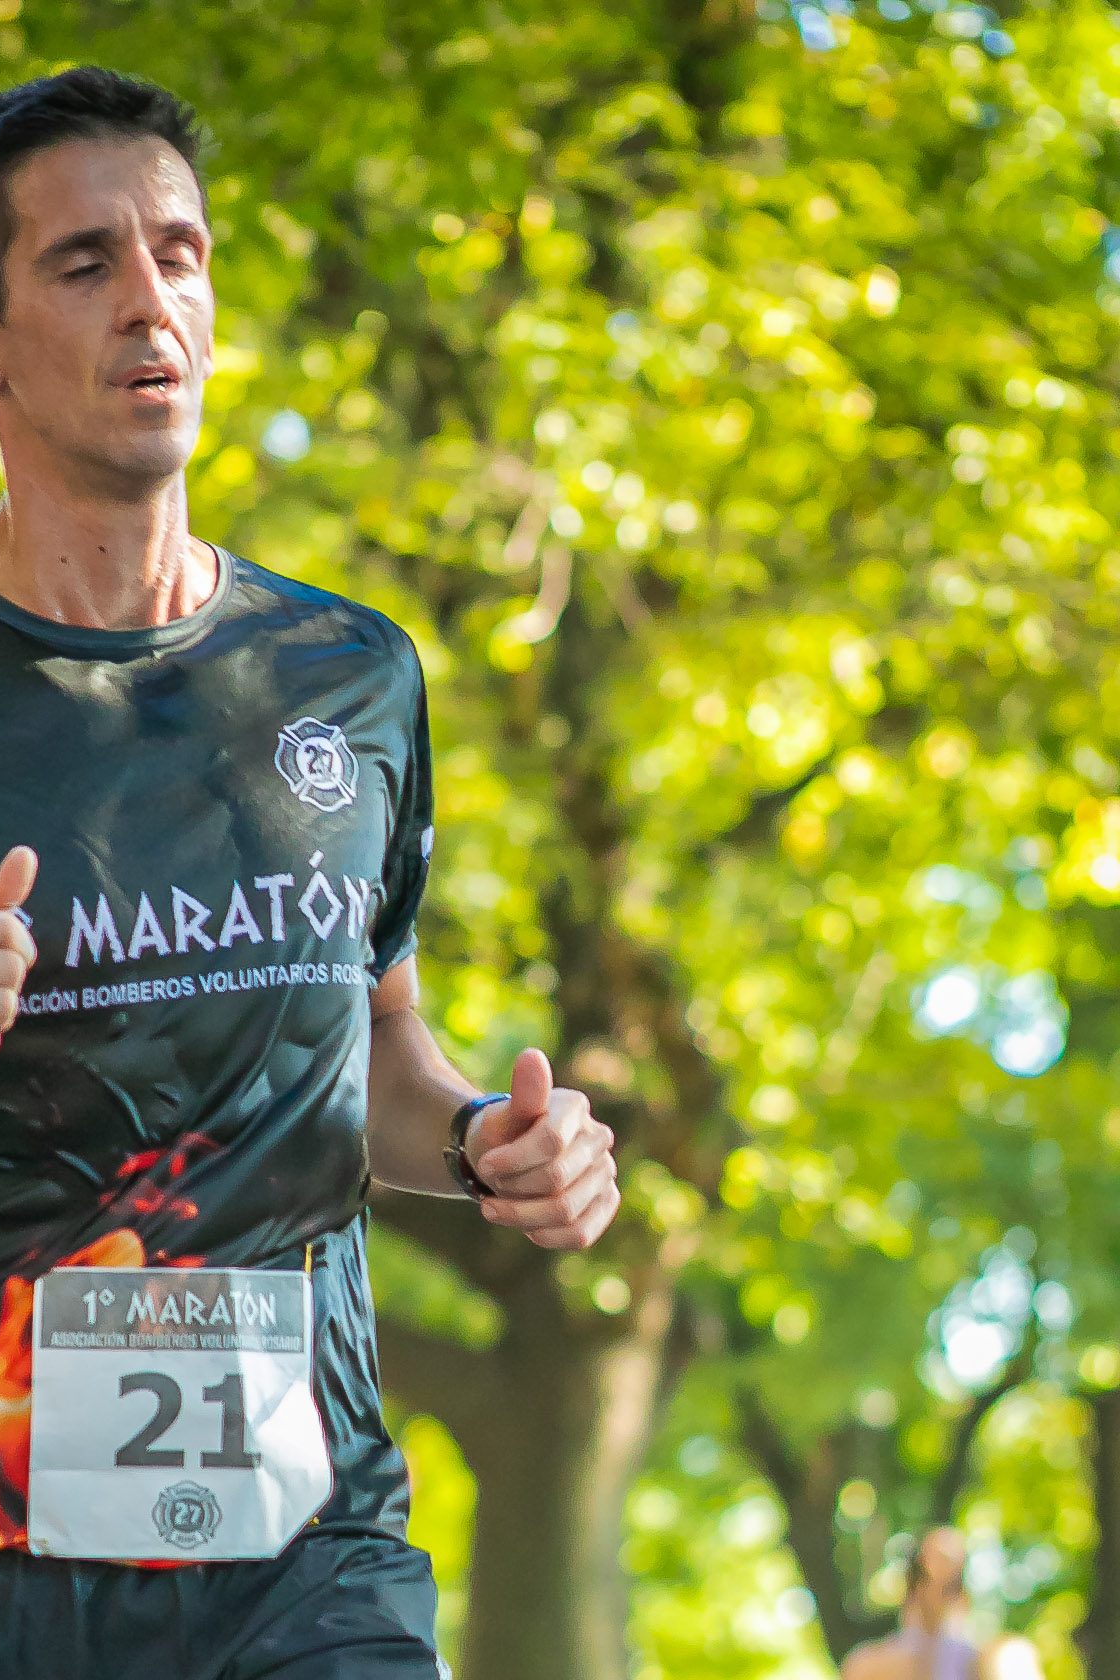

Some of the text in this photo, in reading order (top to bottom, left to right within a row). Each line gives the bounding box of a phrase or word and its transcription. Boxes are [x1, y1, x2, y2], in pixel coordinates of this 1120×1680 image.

[65, 850, 370, 967] MARATÓN
[82, 976, 196, 1009] BOMBEROS
[198, 962, 330, 996] VOLUNTARIOS
[332, 962, 364, 985] ROS
[126, 1280, 277, 1327] MARATÓN
[114, 1370, 262, 1470] 21
[174, 1502, 201, 1525] 27
